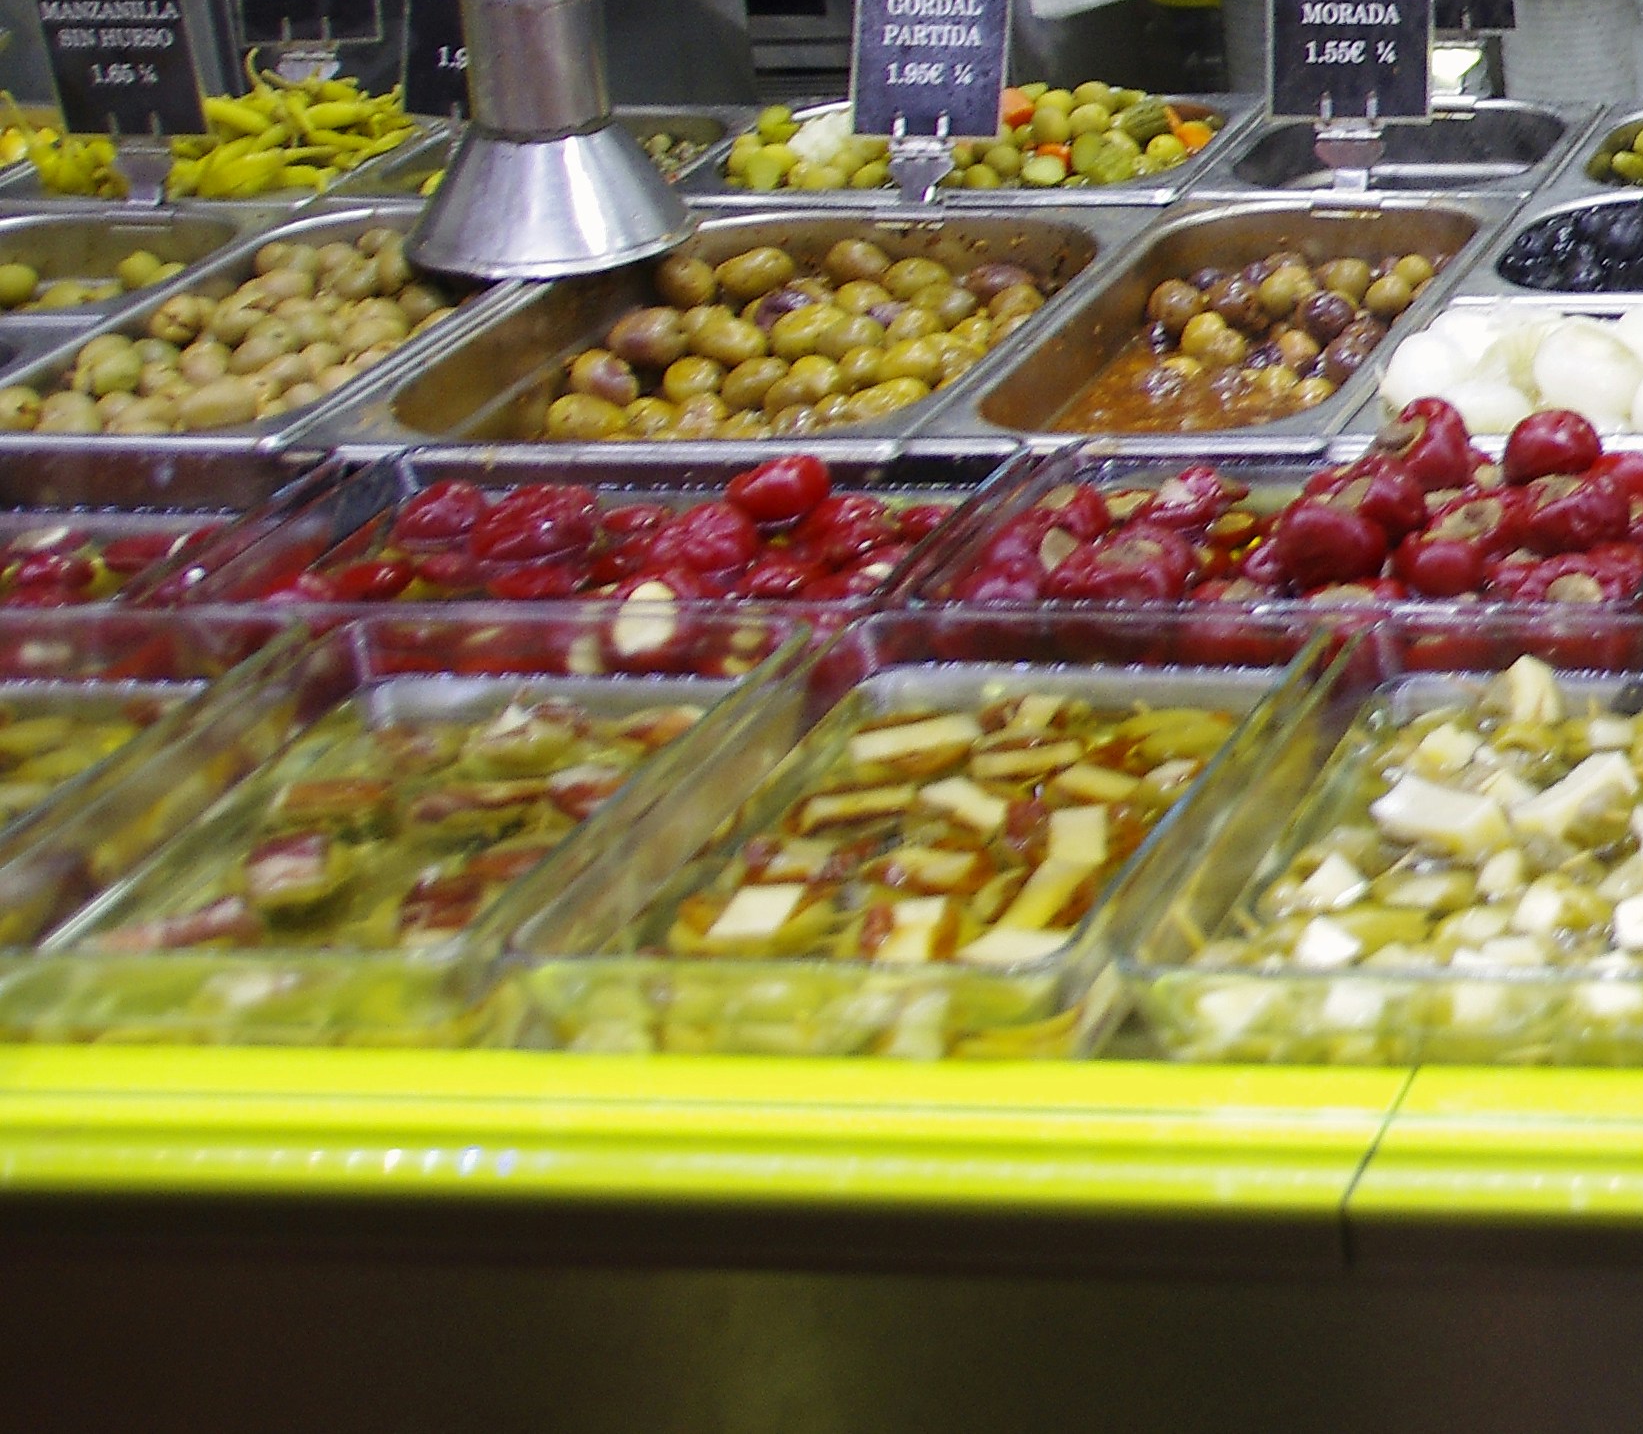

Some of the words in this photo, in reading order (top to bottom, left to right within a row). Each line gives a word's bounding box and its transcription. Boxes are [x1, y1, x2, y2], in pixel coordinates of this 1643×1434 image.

[39, 0, 180, 21] MANZANILLA
[1301, 2, 1401, 25] MORADA
[100, 27, 175, 49] HUESO
[882, 23, 982, 47] PARTIDA
[1304, 41, 1367, 64] 1.55€
